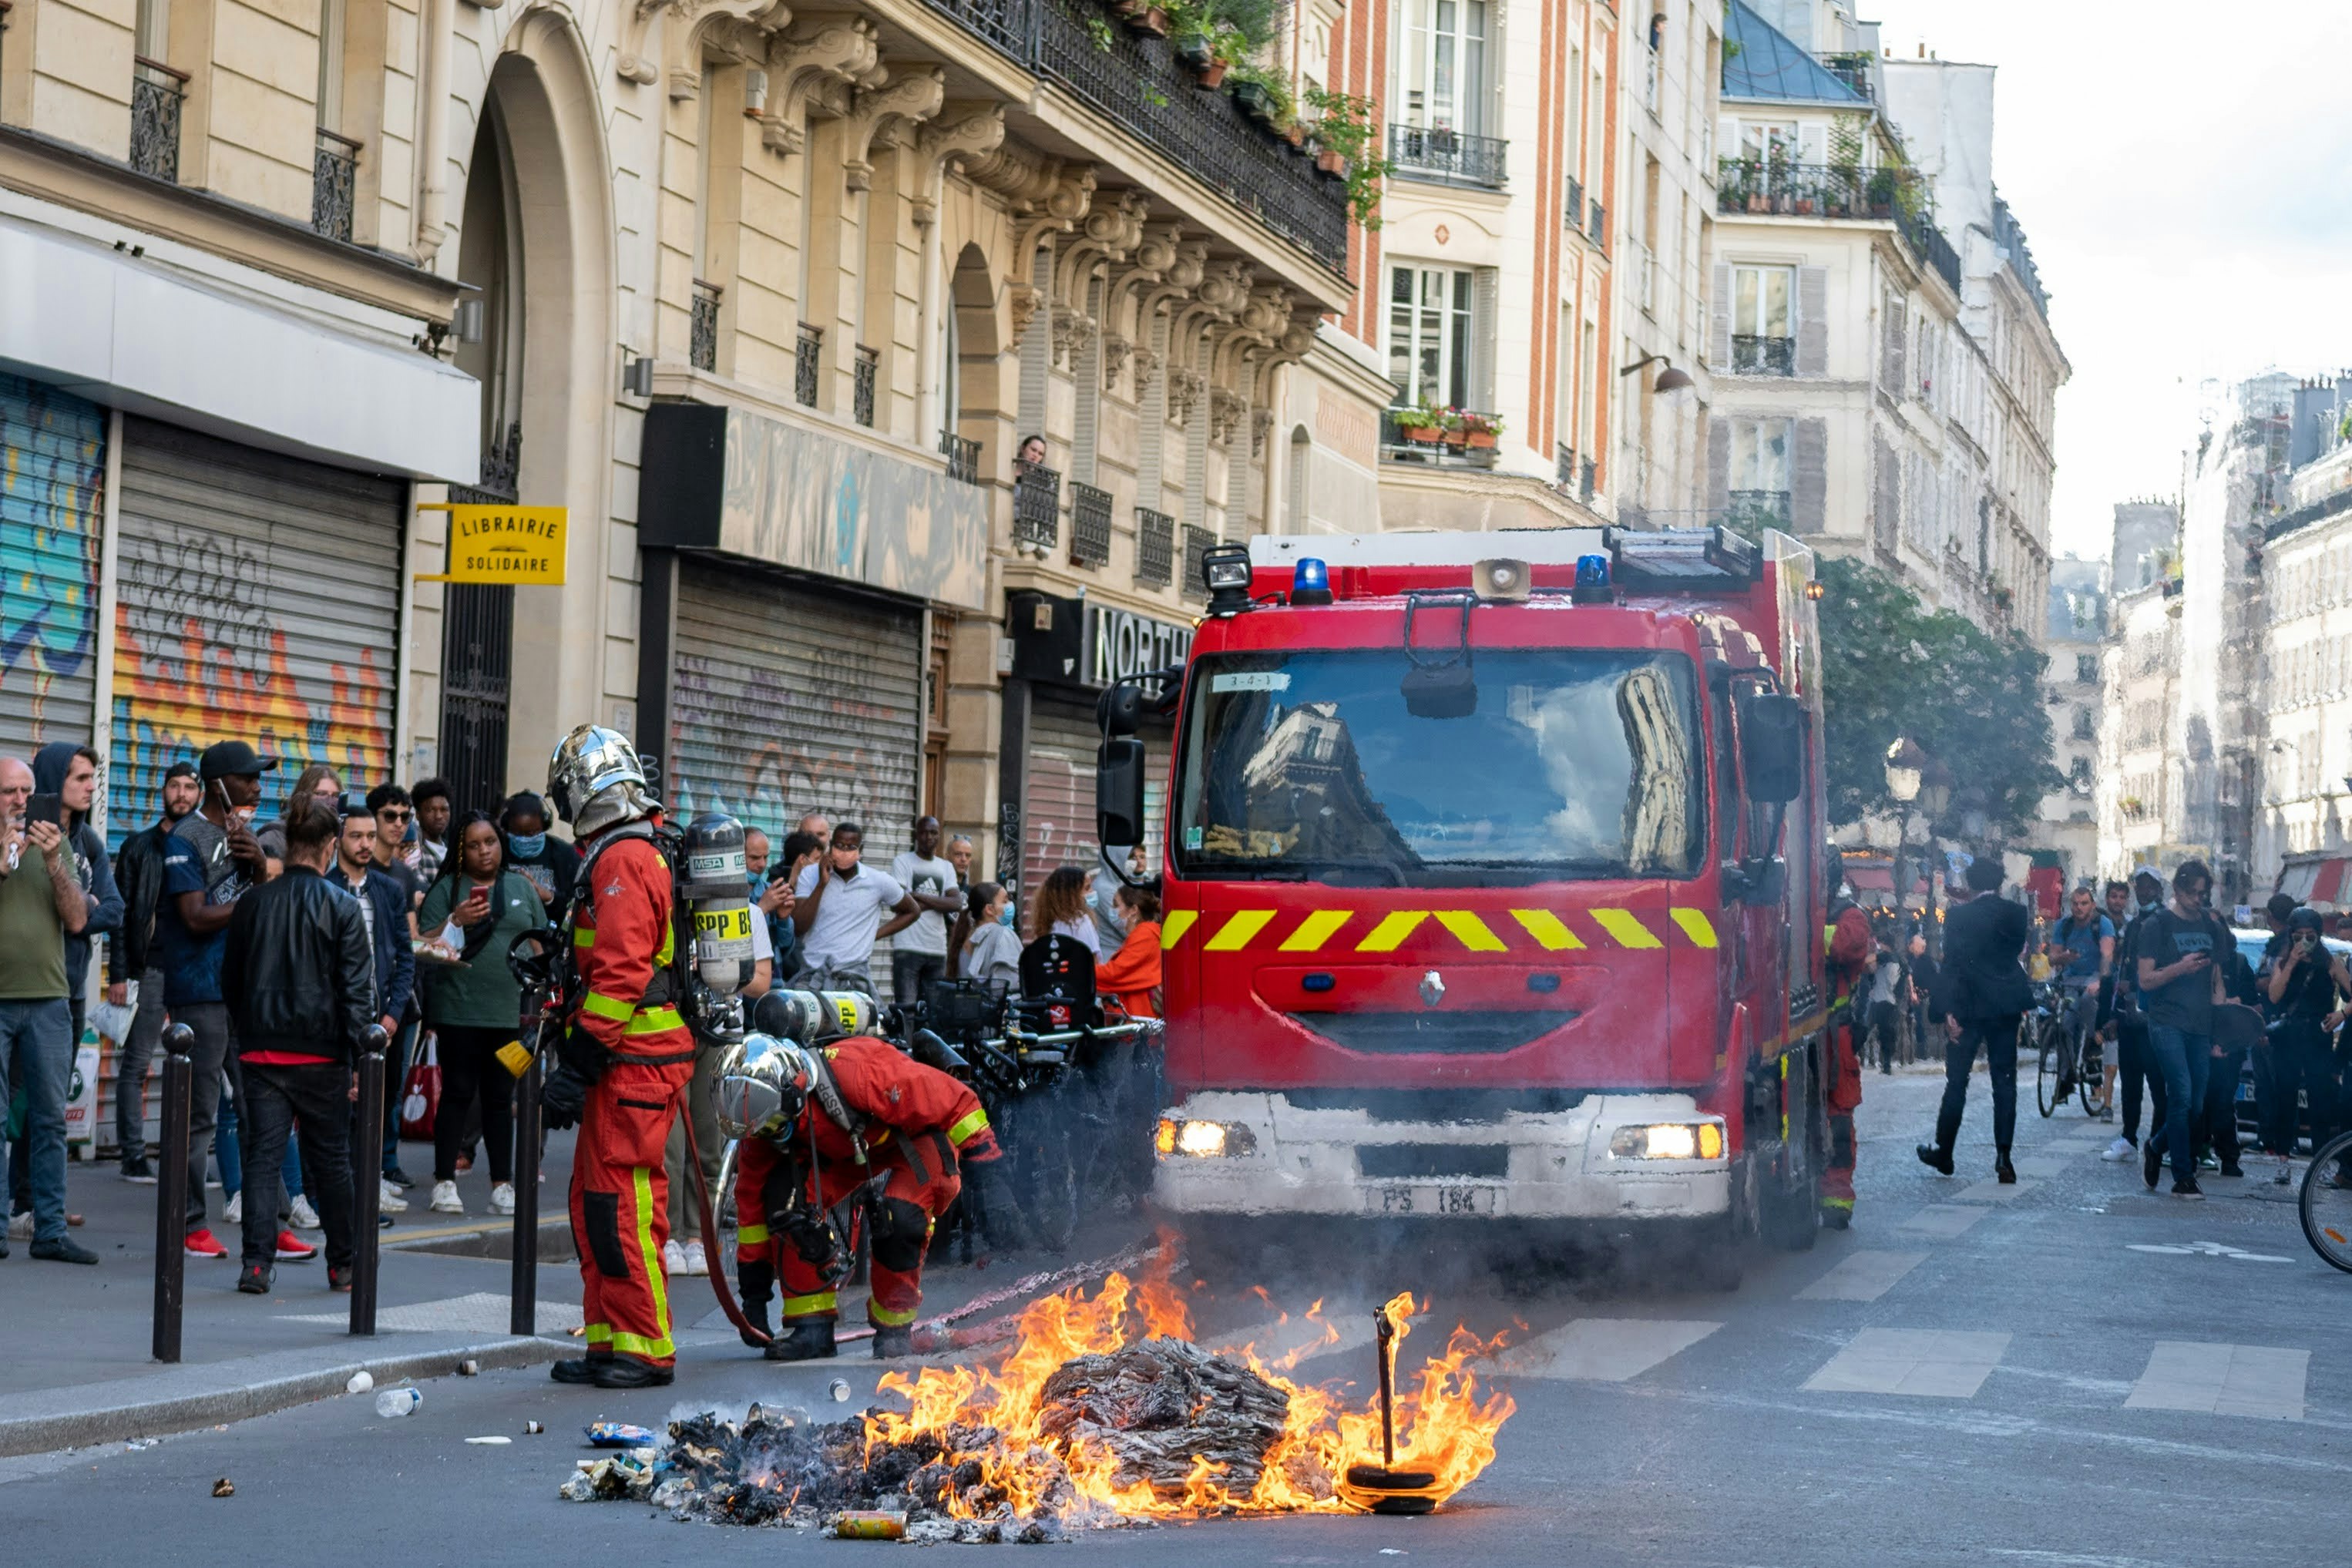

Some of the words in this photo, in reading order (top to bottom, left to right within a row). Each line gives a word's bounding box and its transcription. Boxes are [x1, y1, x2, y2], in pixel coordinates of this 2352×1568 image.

[462, 516, 557, 539] LIBRAIRIE
[467, 556, 549, 572] SOLIDAIRE
[1095, 607, 1194, 694] NORTH
[694, 858, 724, 869] MSA
[695, 914, 729, 938] SPP
[818, 1083, 843, 1116] BSPP
